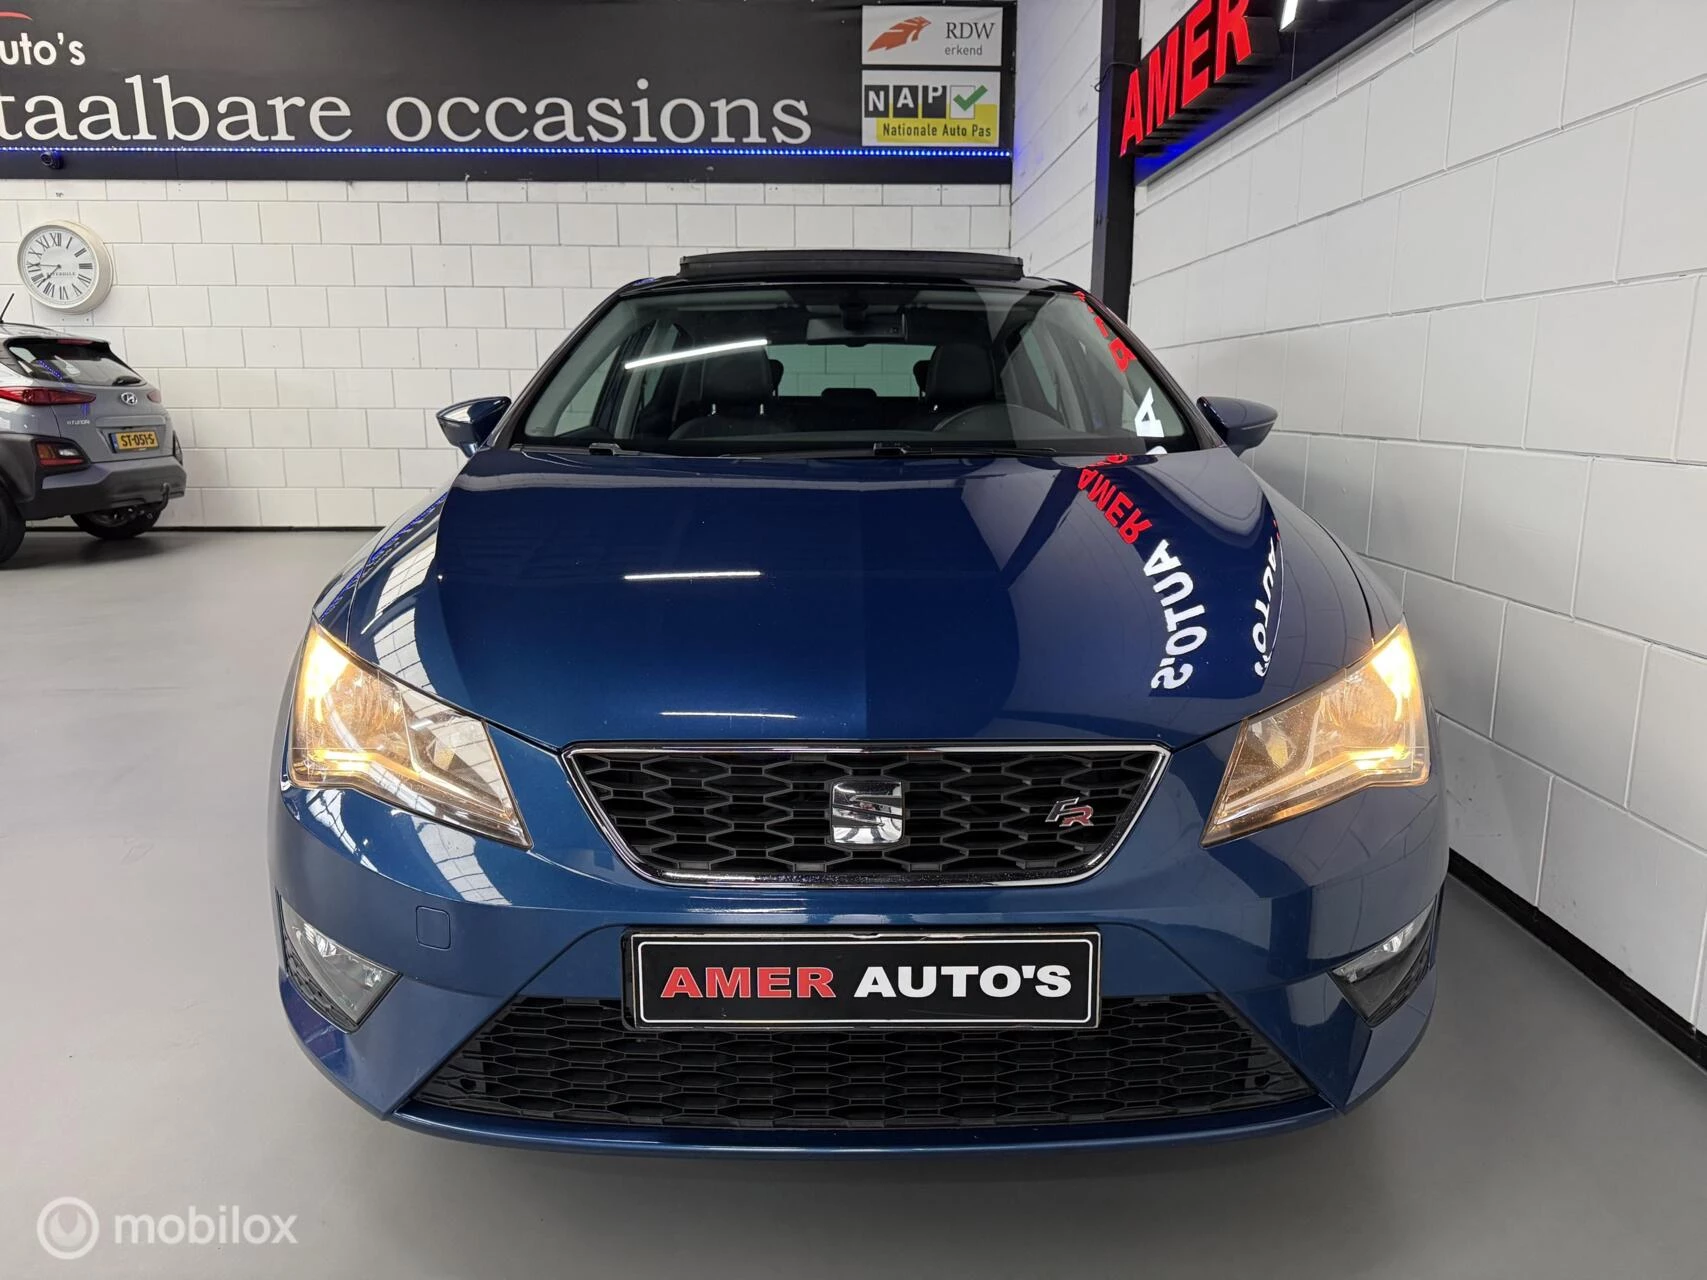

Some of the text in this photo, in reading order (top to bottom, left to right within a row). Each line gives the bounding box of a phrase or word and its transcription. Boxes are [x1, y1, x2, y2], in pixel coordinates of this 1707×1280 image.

[945, 22, 995, 39] RDW
[944, 44, 983, 56] erkend
[1119, 0, 1252, 157] AMER
[386, 78, 812, 144] occasions
[883, 122, 991, 137] Nationale Auto Pas
[1045, 797, 1094, 827] FR
[660, 964, 1072, 999] AMER AUTO'S
